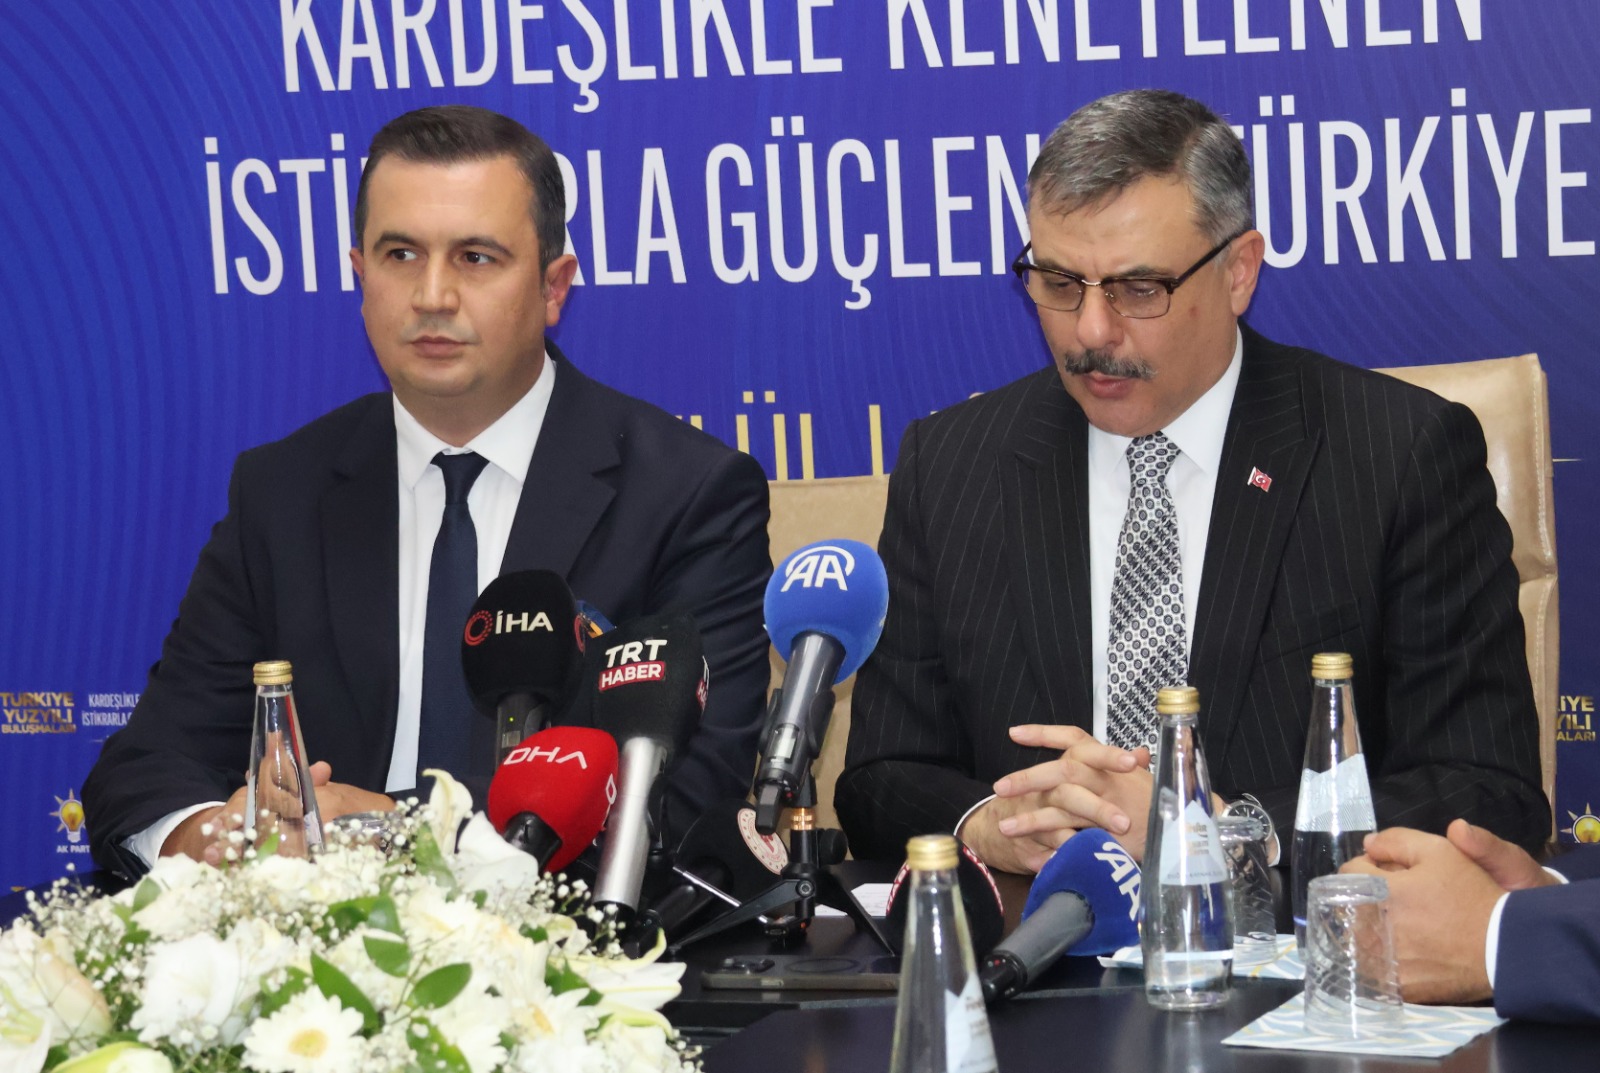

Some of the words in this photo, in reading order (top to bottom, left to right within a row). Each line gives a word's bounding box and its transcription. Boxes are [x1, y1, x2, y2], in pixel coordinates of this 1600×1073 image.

[1230, 88, 1596, 269] ÜRKİYE
[780, 549, 851, 592] AA
[495, 610, 554, 634] İHA
[605, 639, 668, 668] TRT
[601, 663, 663, 688] HABER
[503, 746, 588, 769] DHA
[70, 844, 91, 854] PART
